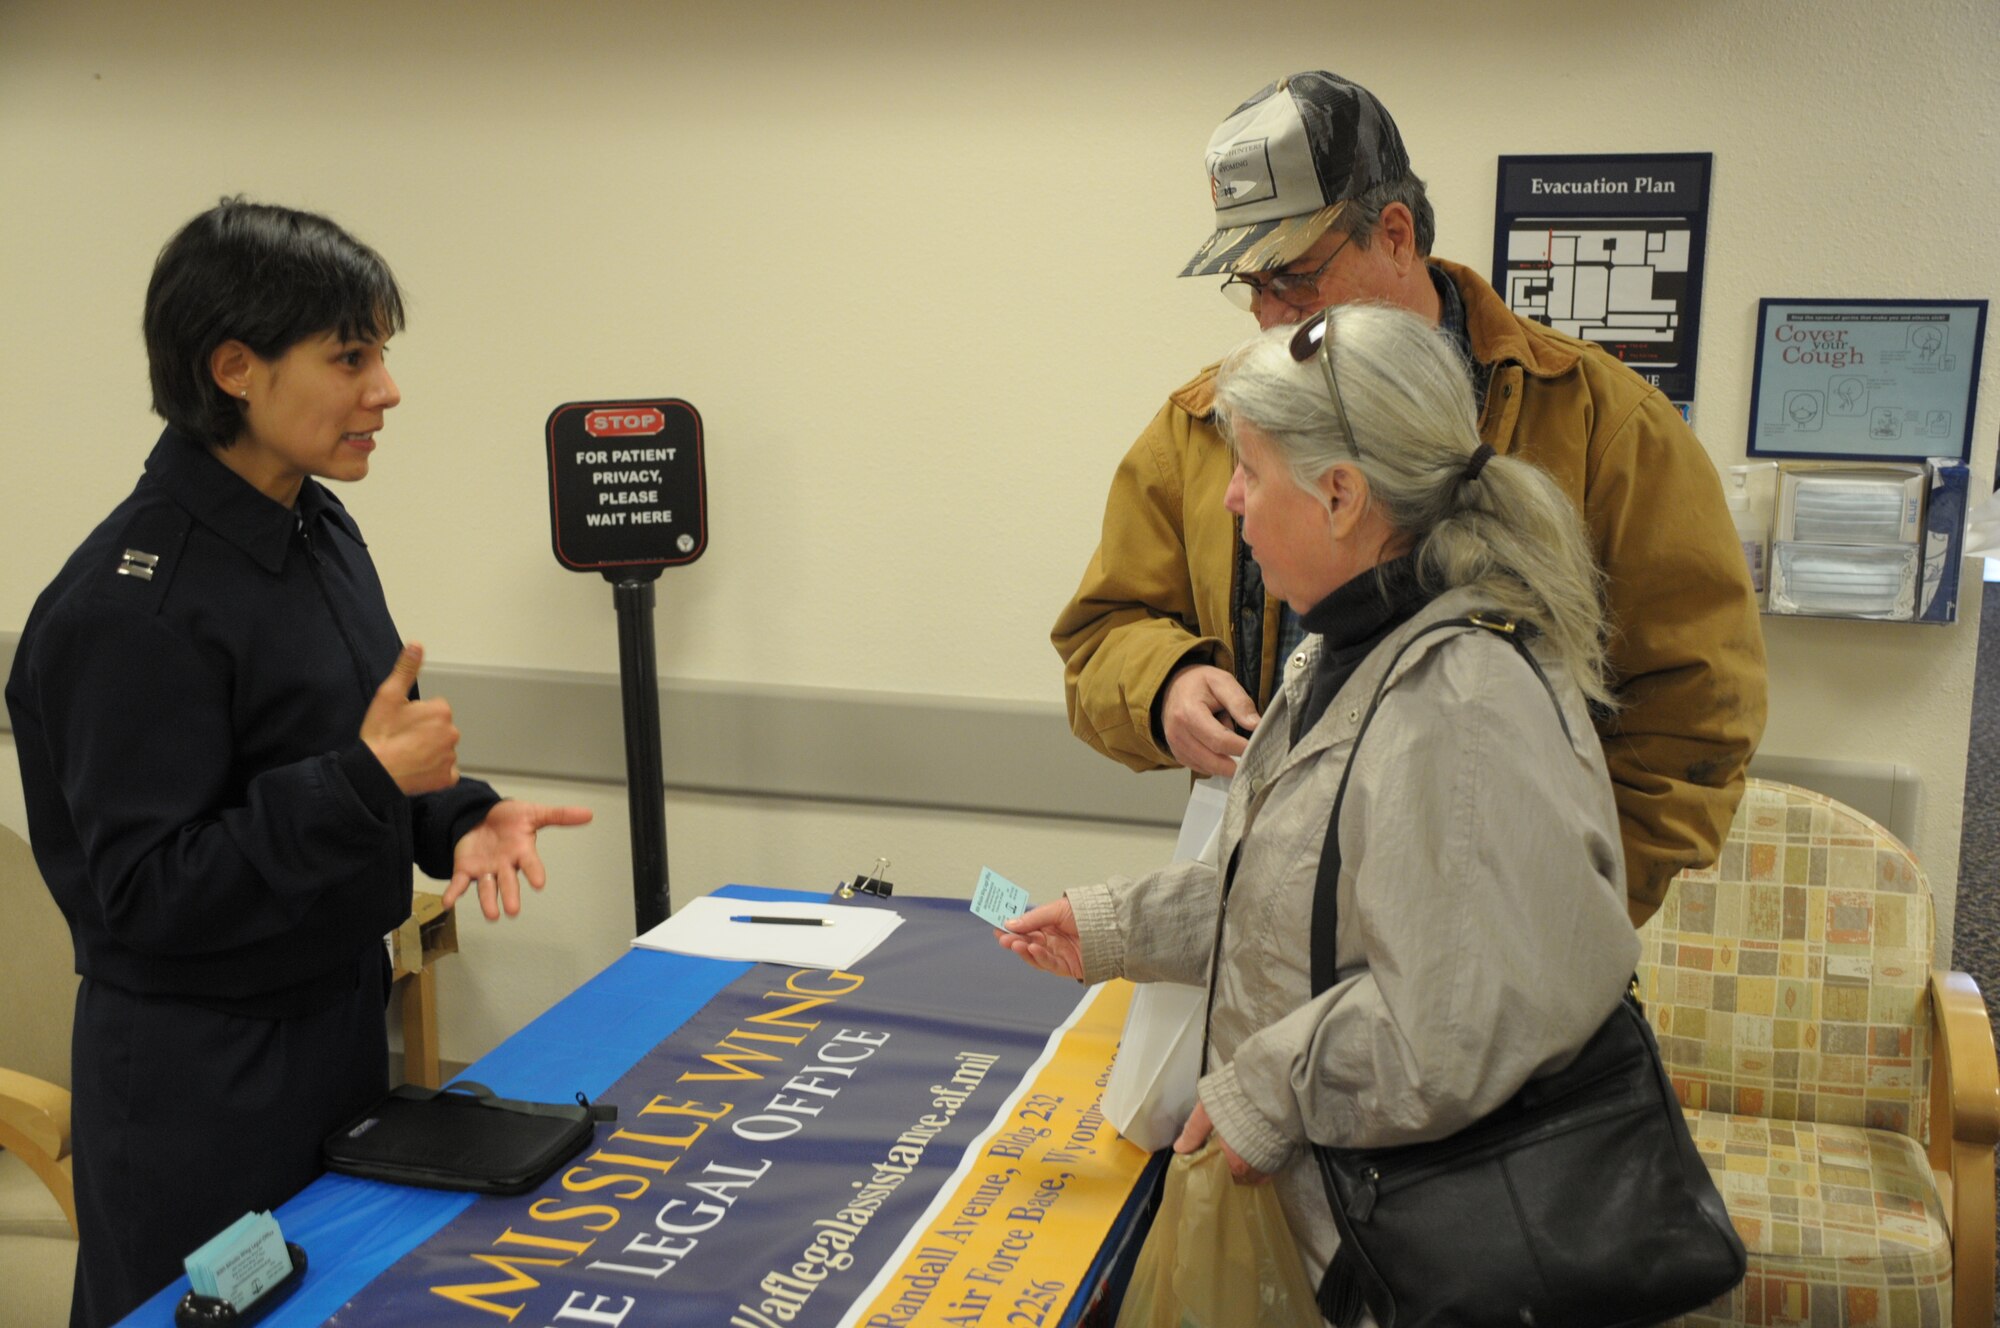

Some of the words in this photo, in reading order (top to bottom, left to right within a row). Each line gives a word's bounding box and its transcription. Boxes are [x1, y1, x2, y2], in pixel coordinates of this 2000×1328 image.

[1530, 177, 1629, 195] Evacuation
[1633, 176, 1676, 194] Plan
[1775, 324, 1849, 343] Cover
[1812, 340, 1849, 351] your
[1782, 346, 1864, 369] Cough
[594, 414, 656, 430] STOP
[576, 450, 608, 465] FOR
[611, 447, 677, 464] PATIENT
[592, 469, 663, 485] PRIVACY,
[599, 490, 659, 505] PLEASE
[1908, 496, 1918, 523] BLUE
[586, 512, 627, 527] WAIT
[630, 510, 673, 525] HERE
[1019, 1093, 1065, 1122] 232
[429, 1094, 734, 1324] MISSILE
[676, 968, 865, 1084] WING
[585, 1158, 773, 1280] LEGAL
[732, 1028, 891, 1142] OFFICE
[987, 1125, 1052, 1161] Bldg
[934, 1168, 1022, 1245] Avenue,
[1005, 1172, 1077, 1225] Base,
[964, 1228, 1034, 1286] Force
[863, 1247, 959, 1328] Randall
[939, 1288, 993, 1328] Air
